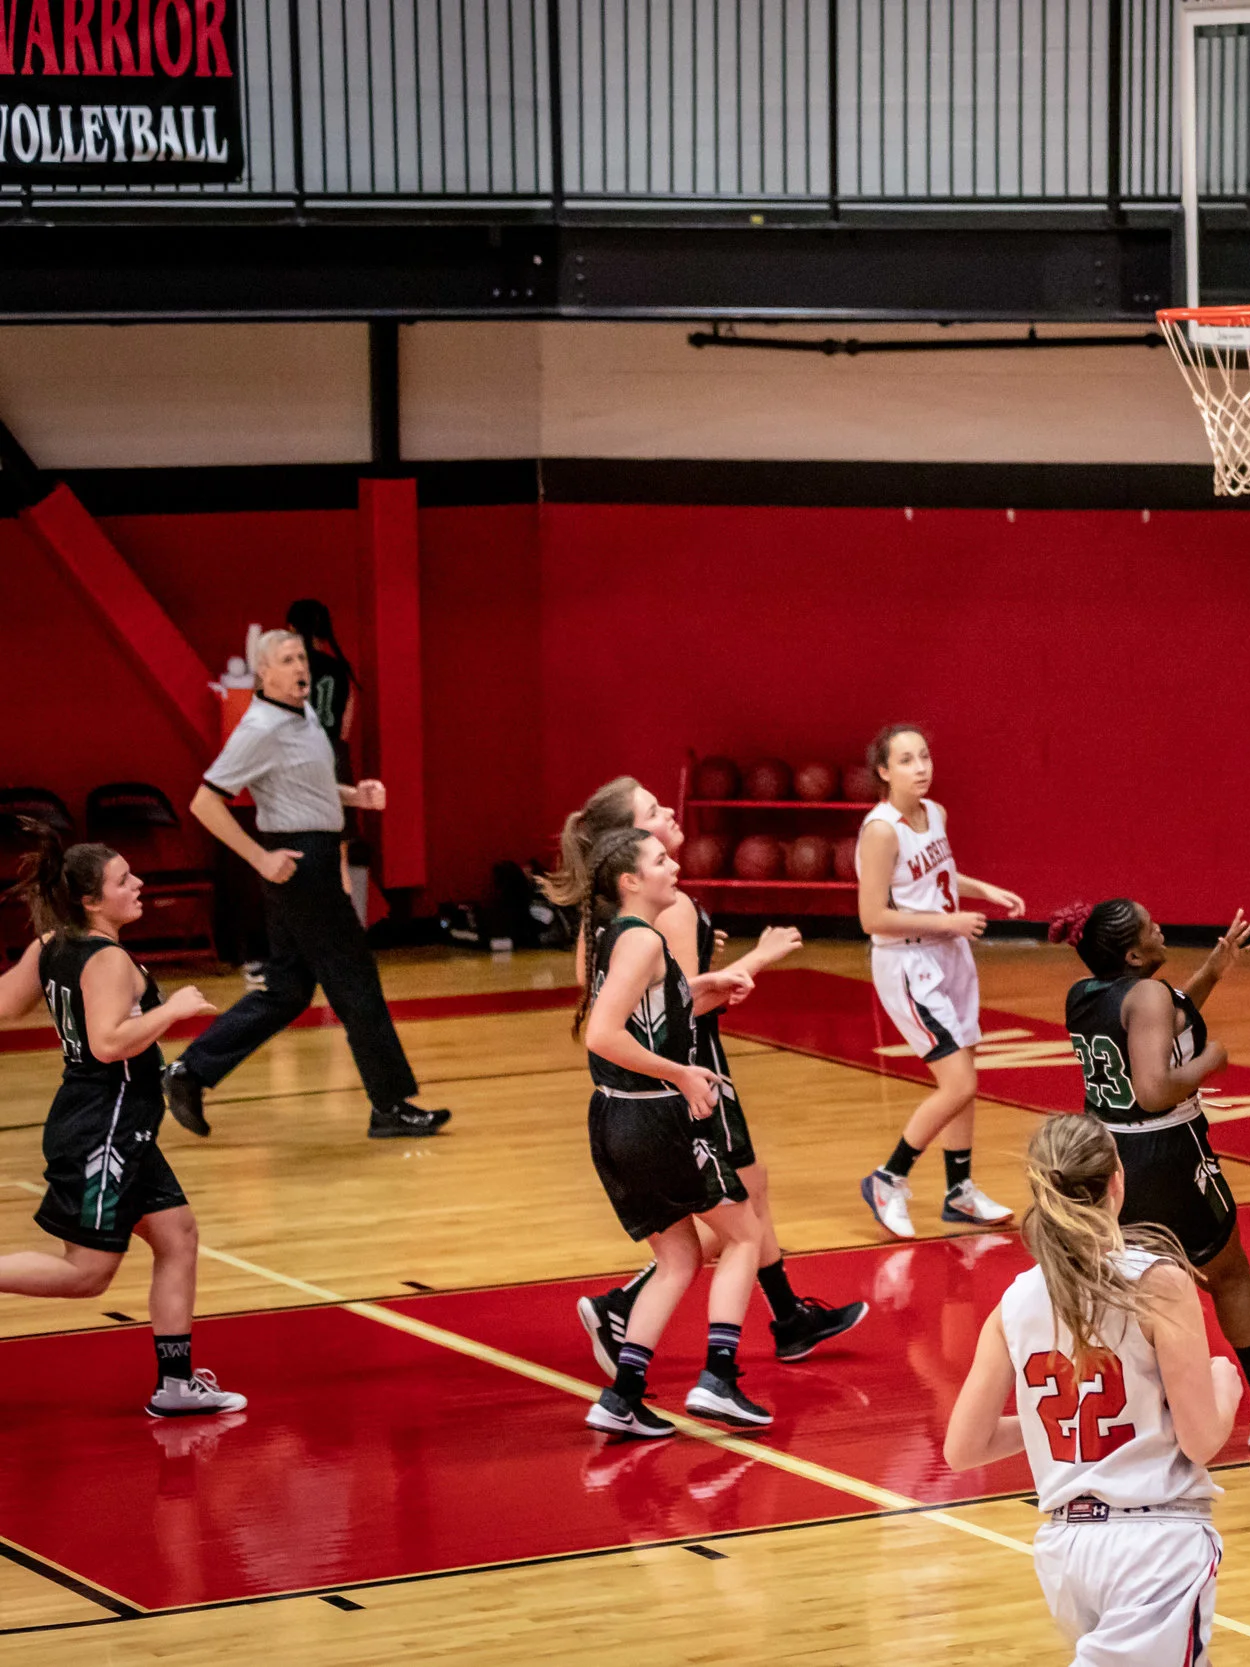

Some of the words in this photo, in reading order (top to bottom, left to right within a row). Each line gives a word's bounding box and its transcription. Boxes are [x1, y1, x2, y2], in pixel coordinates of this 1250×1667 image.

[936, 869, 956, 913] 3
[45, 979, 83, 1064] 14
[1069, 1033, 1136, 1109] 23
[1023, 1346, 1136, 1464] 22
